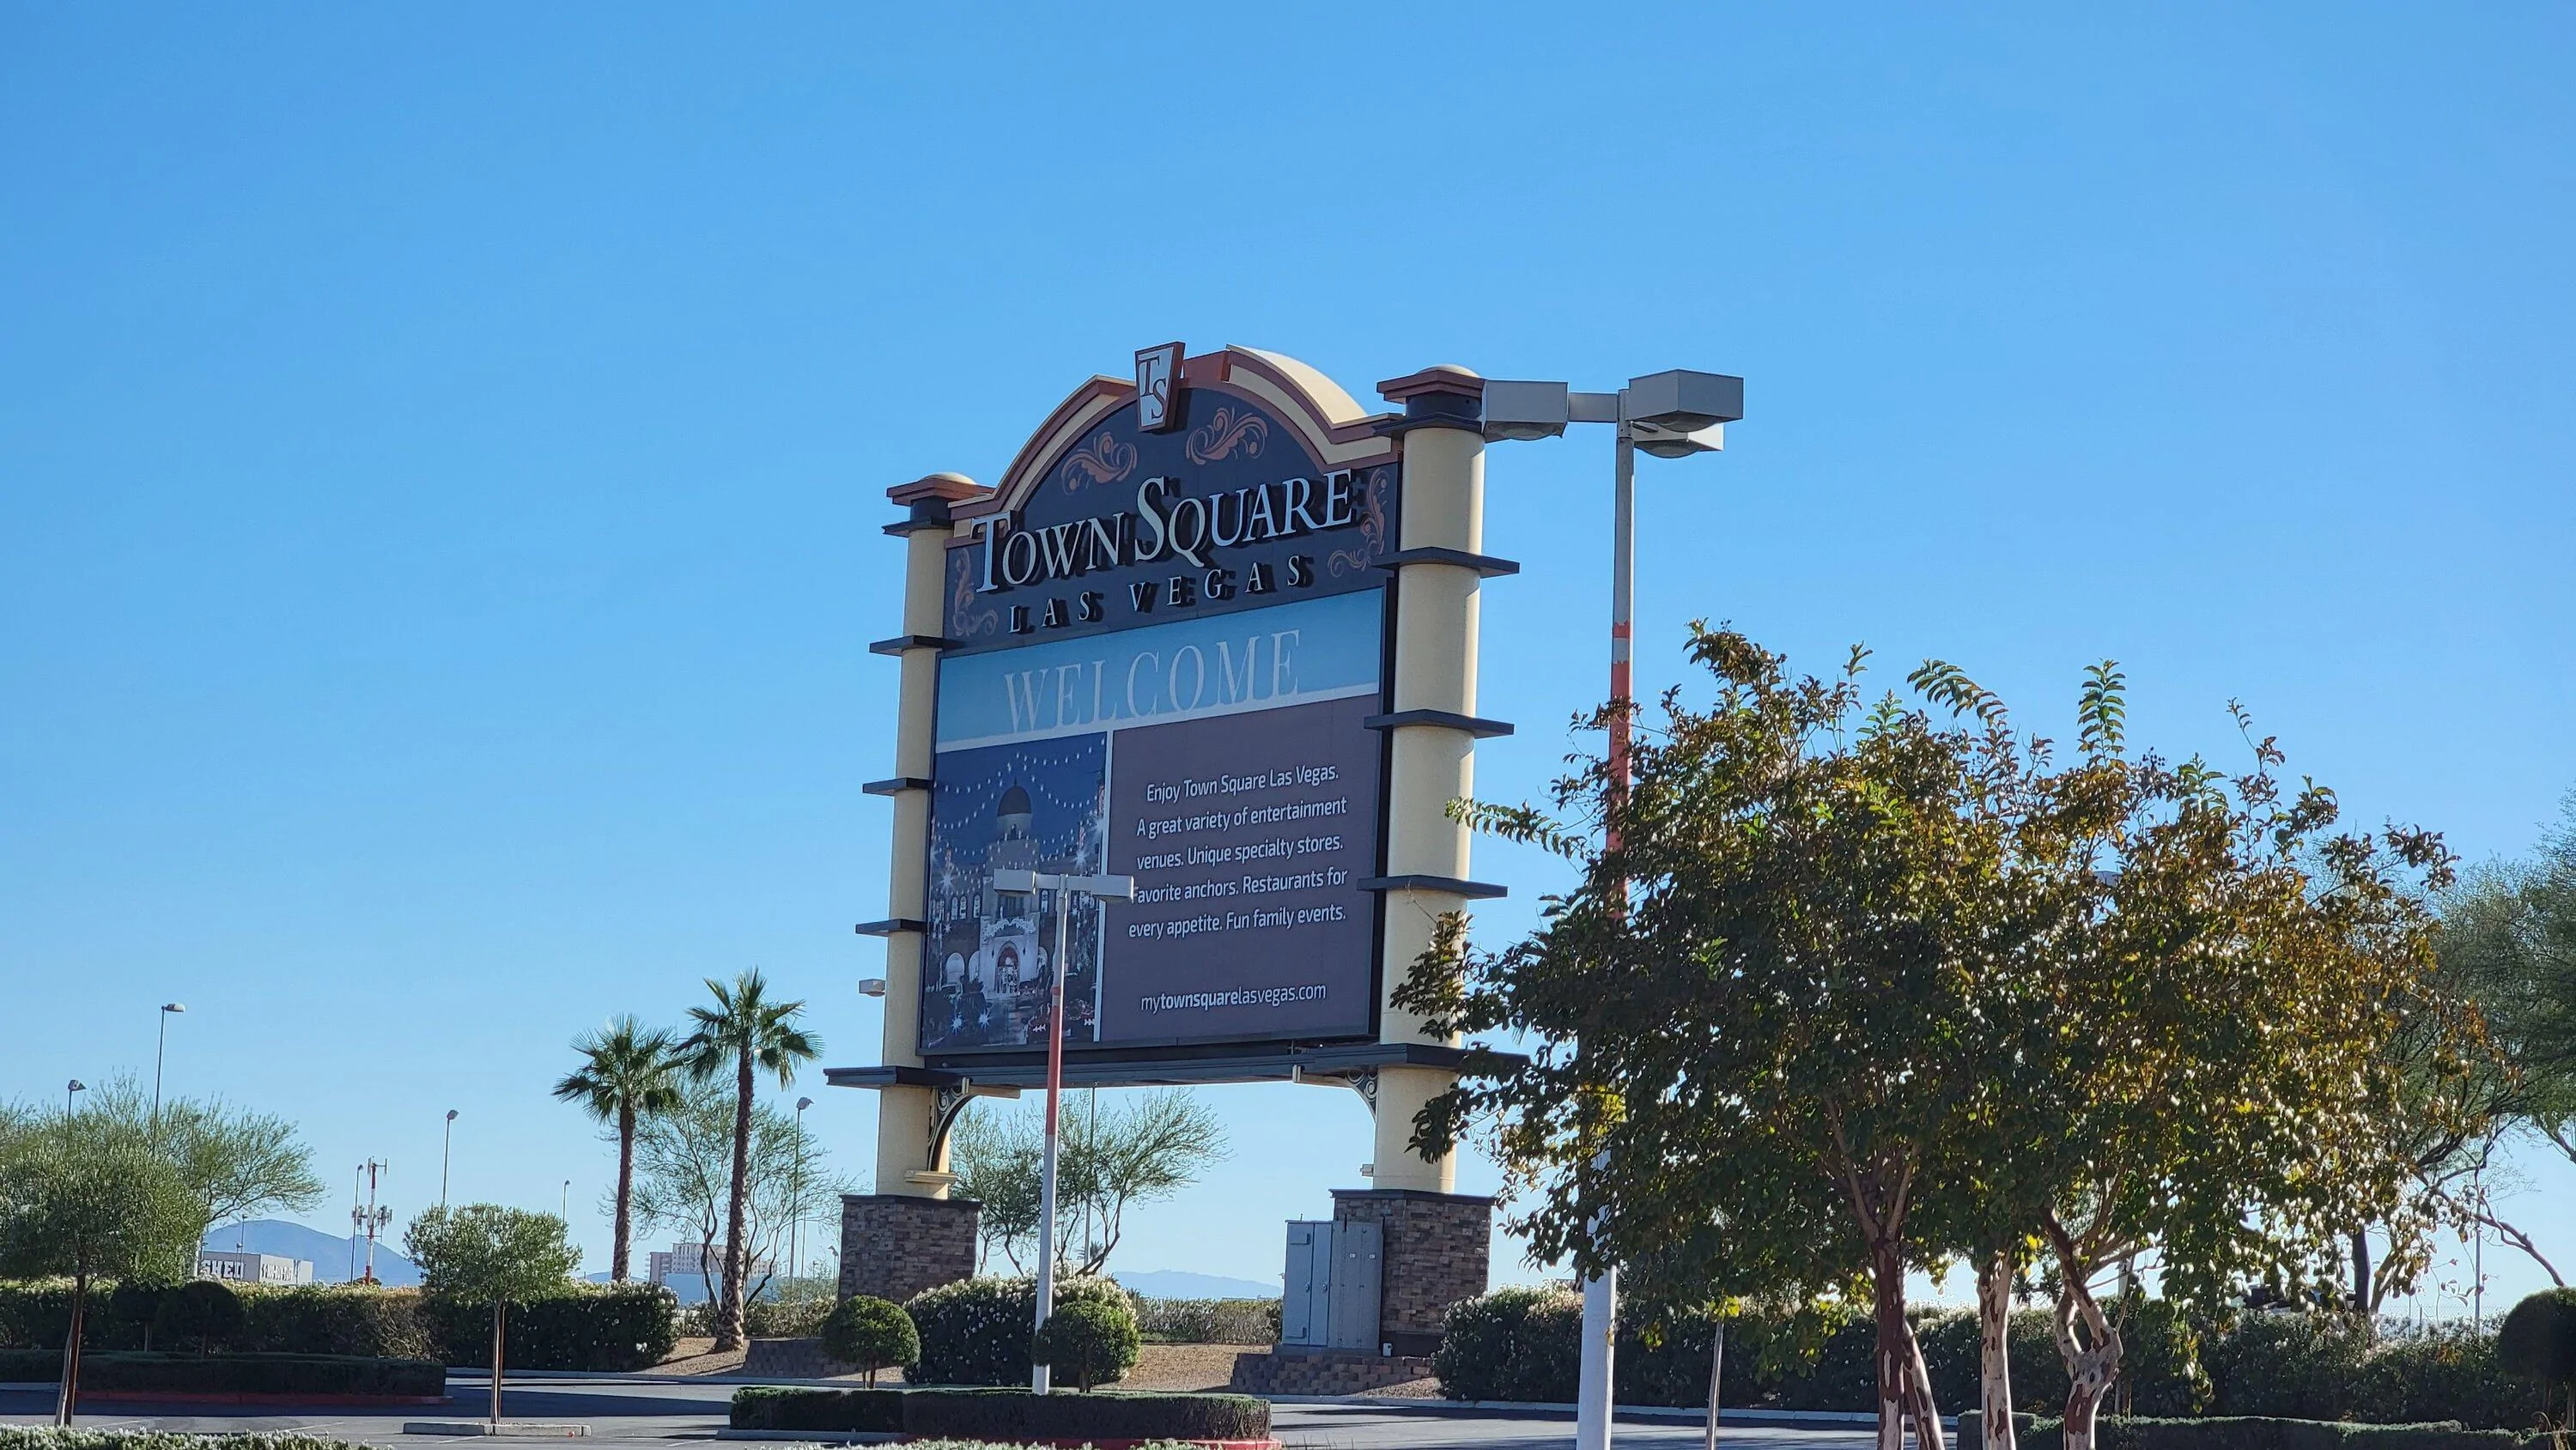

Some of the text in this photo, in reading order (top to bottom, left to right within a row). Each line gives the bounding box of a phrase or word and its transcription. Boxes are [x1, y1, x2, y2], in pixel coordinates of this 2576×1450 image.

[971, 469, 1352, 593] TOWN SQUARE
[1008, 555, 1302, 634] LAS VEGAS
[1004, 629, 1301, 733] WELCOME
[1146, 764, 1340, 804] Enjoy Town Square Las Vegas.
[1137, 797, 1346, 840] A great variety of entertainment
[1137, 835, 1344, 871] venues. Unique specialty stores.
[1184, 878, 1239, 900] anchors.
[1242, 871, 1324, 895] Restaurants
[1327, 866, 1349, 886] for
[1128, 903, 1346, 941] every appetite. Fun family events.
[1140, 984, 1327, 1015] mytownsquarelasvegas.com
